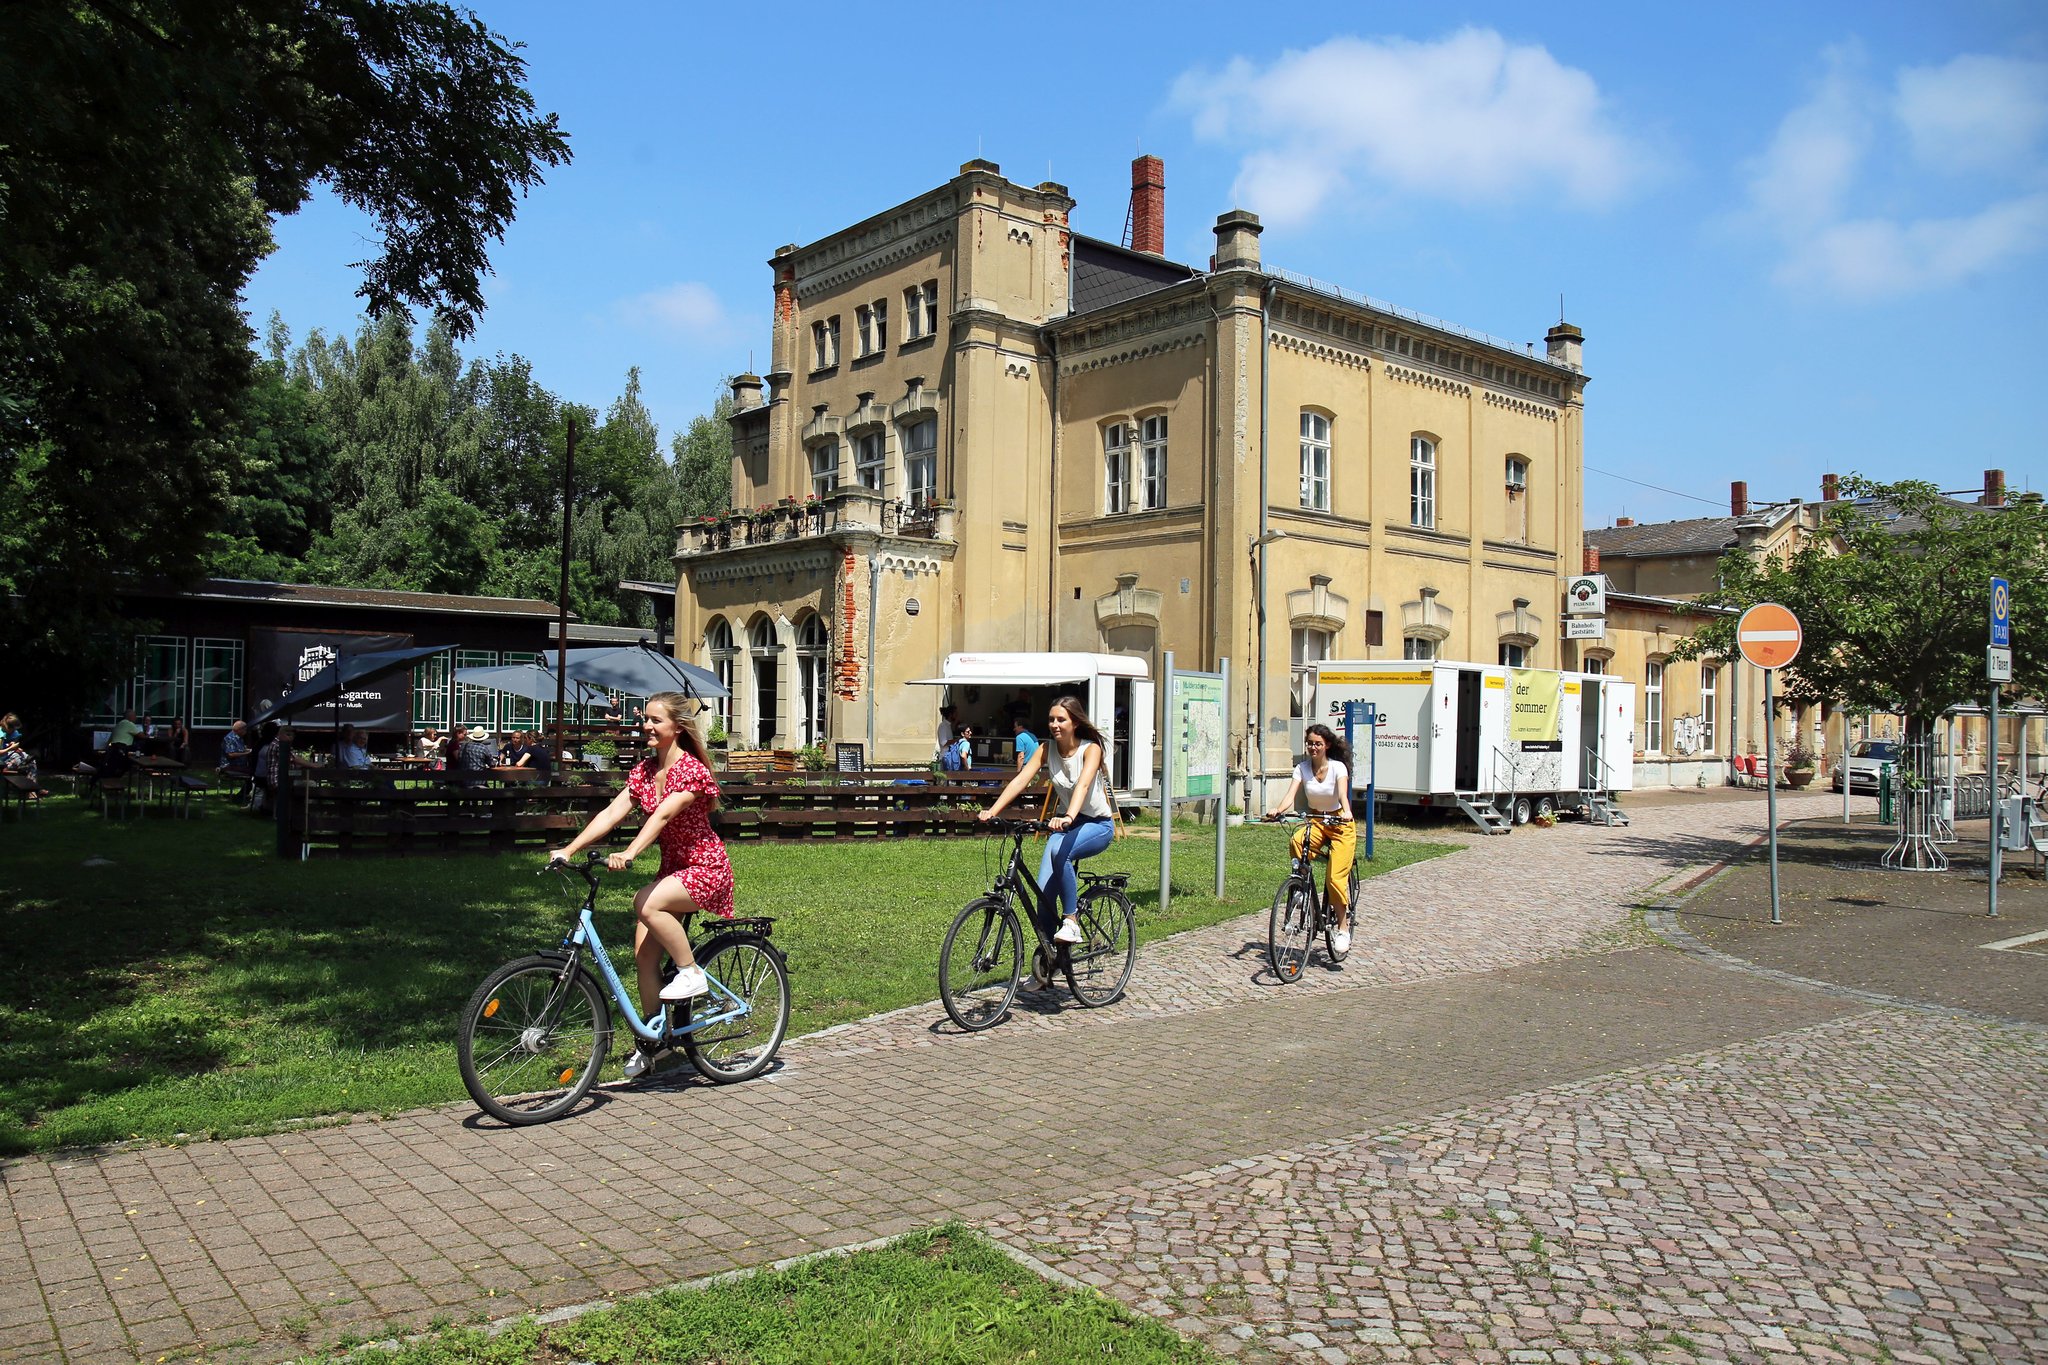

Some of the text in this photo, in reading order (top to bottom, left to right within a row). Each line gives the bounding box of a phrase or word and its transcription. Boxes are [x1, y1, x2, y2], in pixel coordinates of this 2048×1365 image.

[1994, 624, 2007, 640] TAXI
[1992, 655, 2009, 671] 2 Taxen
[1516, 682, 1529, 695] der
[1515, 702, 1547, 714] sommer
